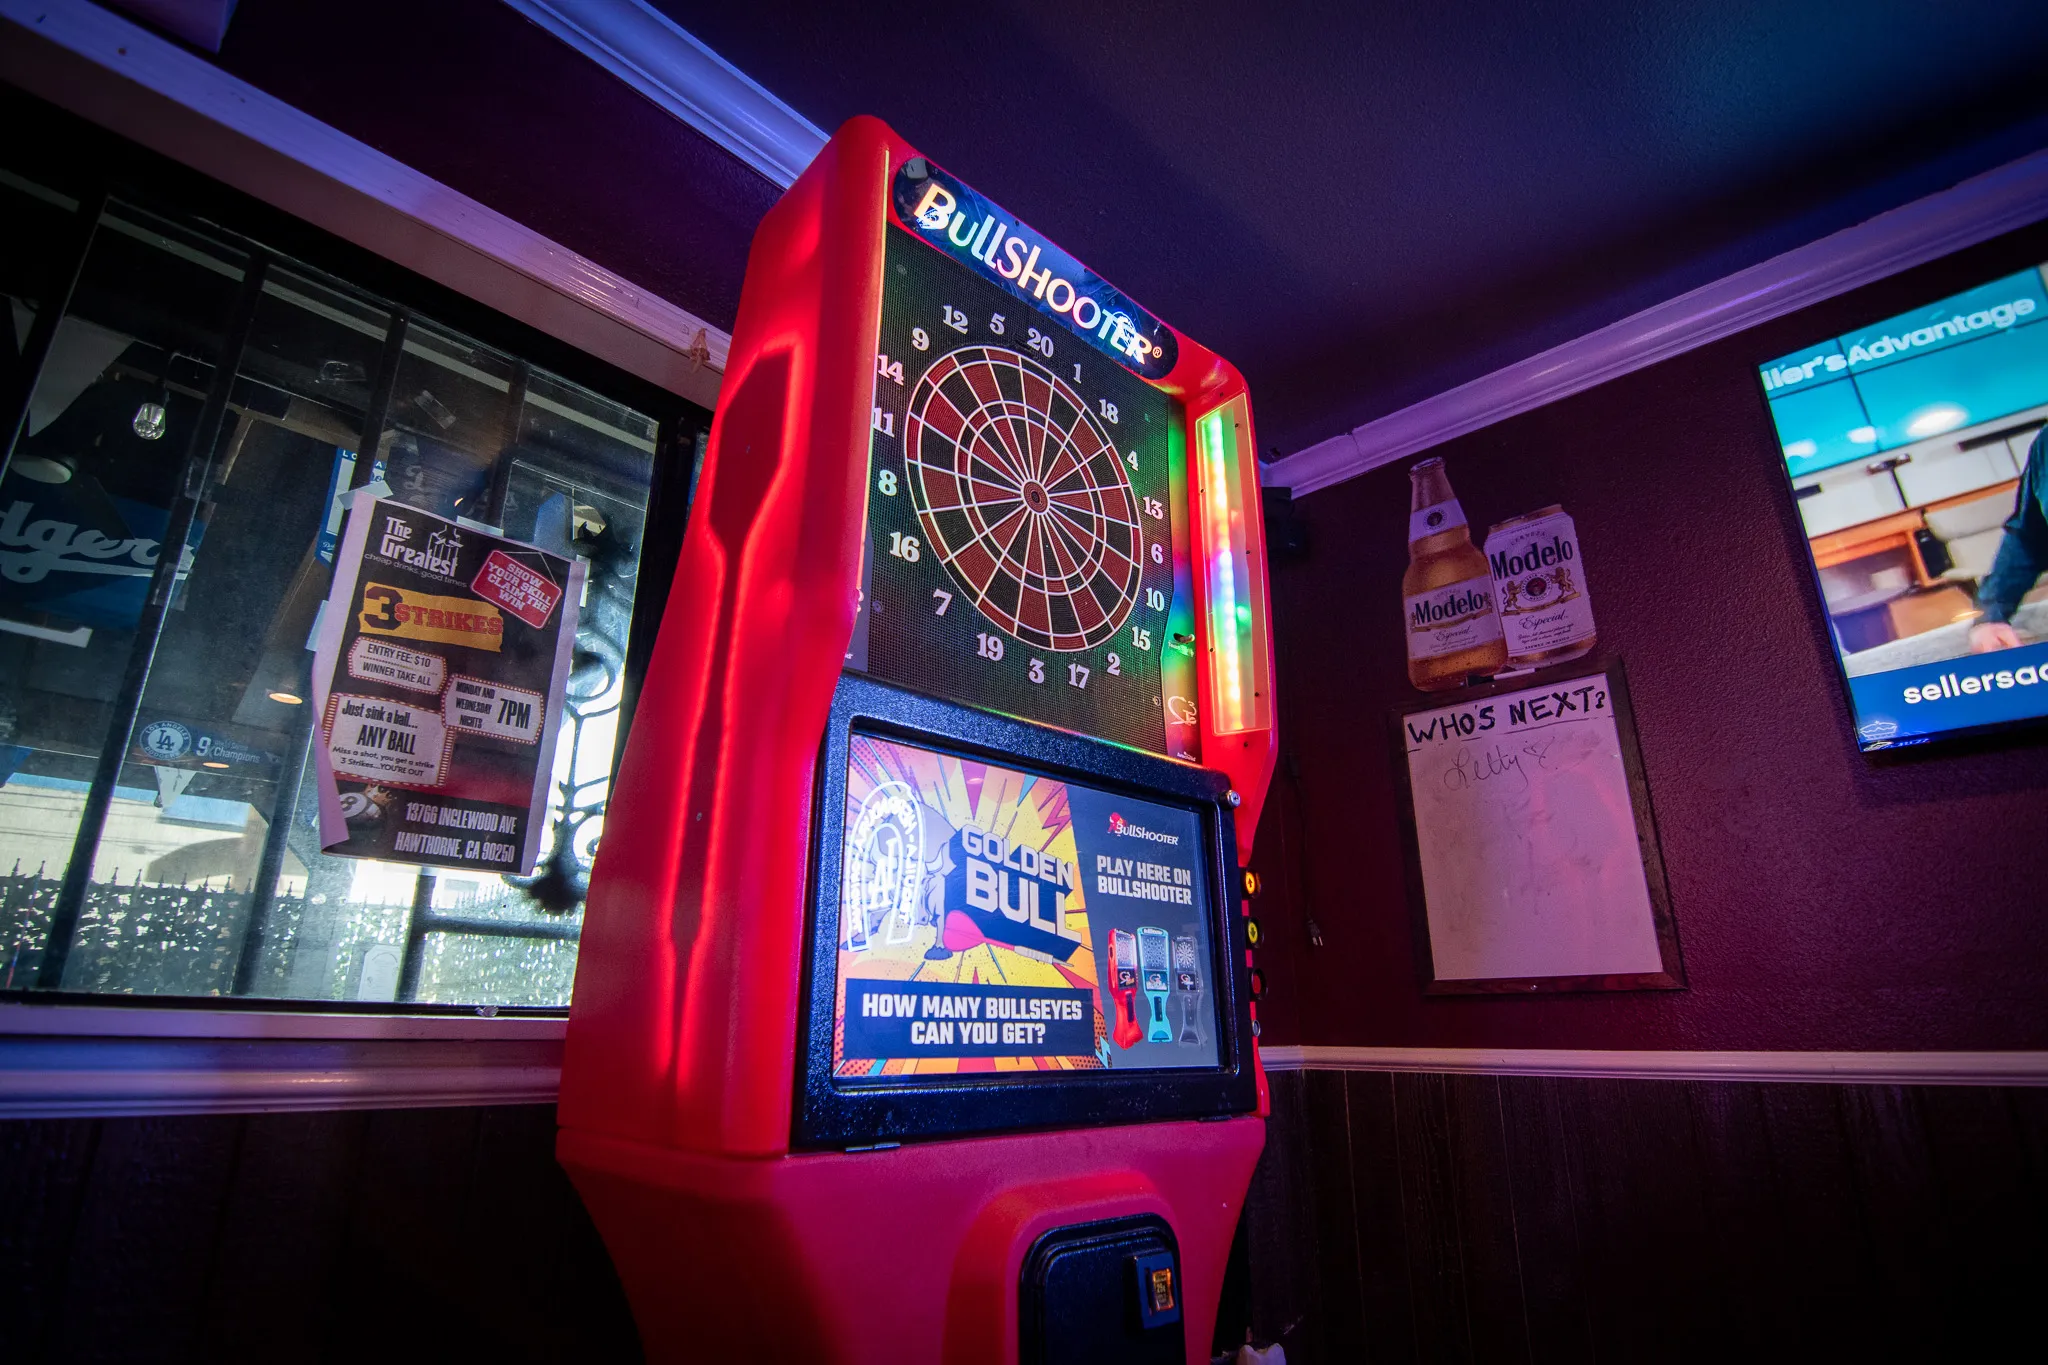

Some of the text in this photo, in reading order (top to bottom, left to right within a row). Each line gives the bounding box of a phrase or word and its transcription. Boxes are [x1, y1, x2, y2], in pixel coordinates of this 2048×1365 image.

[943, 305, 968, 334] 12
[989, 313, 1005, 335] 5
[912, 327, 929, 351] 9
[1027, 328, 1054, 357] 20
[878, 355, 904, 385] 14
[1073, 364, 1082, 383] 1
[873, 408, 894, 437] 11
[1099, 399, 1119, 424] 18
[1126, 450, 1139, 471] 4
[878, 469, 897, 496] 8
[1143, 496, 1164, 520] 13
[387, 516, 412, 540] The
[380, 534, 458, 577] Greatest
[890, 531, 920, 562] 16
[1151, 544, 1164, 564] 6
[1490, 535, 1573, 581] Modelo
[364, 552, 392, 566] cheap
[420, 567, 443, 583] good
[445, 576, 468, 589] times
[506, 562, 544, 588] SHOW
[487, 573, 550, 614] CLAIM THE
[488, 561, 552, 607] YOUR SKILL
[364, 586, 503, 636] 3 STRIKES
[499, 589, 523, 611] WIN
[932, 588, 952, 616] 7
[1146, 588, 1165, 611] 10
[1415, 589, 1483, 625] Modelo
[1520, 609, 1566, 630] Especial
[976, 633, 1004, 661] 19
[1131, 626, 1151, 651] 15
[368, 643, 431, 669] ENTRY FEE: $10
[1107, 653, 1121, 676] 2
[363, 661, 432, 687] WINNER TAKE ALL
[1028, 657, 1045, 684] 3
[1068, 664, 1090, 689] 17
[456, 681, 496, 700] MONDAY AND
[341, 699, 364, 717] Just
[365, 704, 386, 721] sink
[387, 712, 394, 723] a
[455, 698, 493, 715] WEDNESDAY
[497, 697, 532, 730] 7PM
[1407, 685, 1606, 743] WHO'S NEXT?
[145, 722, 189, 740] LOS ANGELES
[459, 714, 483, 729] NIGHTS
[156, 729, 175, 751] LA
[356, 724, 416, 755] ANY BALL
[213, 745, 260, 763] Champions
[332, 746, 352, 759] Miss
[360, 749, 378, 761] shot,
[380, 755, 394, 766] you
[395, 757, 408, 768] get
[414, 759, 435, 770] strike
[340, 757, 347, 765] 3
[408, 767, 424, 777] OUT
[405, 802, 517, 835] 13766 INGLEWOOD AVE
[394, 831, 515, 863] HAWTHORNE, CA 90250
[962, 823, 1075, 890] GOLDEN
[1097, 855, 1191, 886] PLAY HERE ON
[966, 856, 1083, 944] BULL
[1098, 875, 1192, 905] BULLSHOOTER
[862, 993, 1083, 1021] HOW MANY BULLSEYES
[911, 1021, 1046, 1045] CAN YOU GET?
